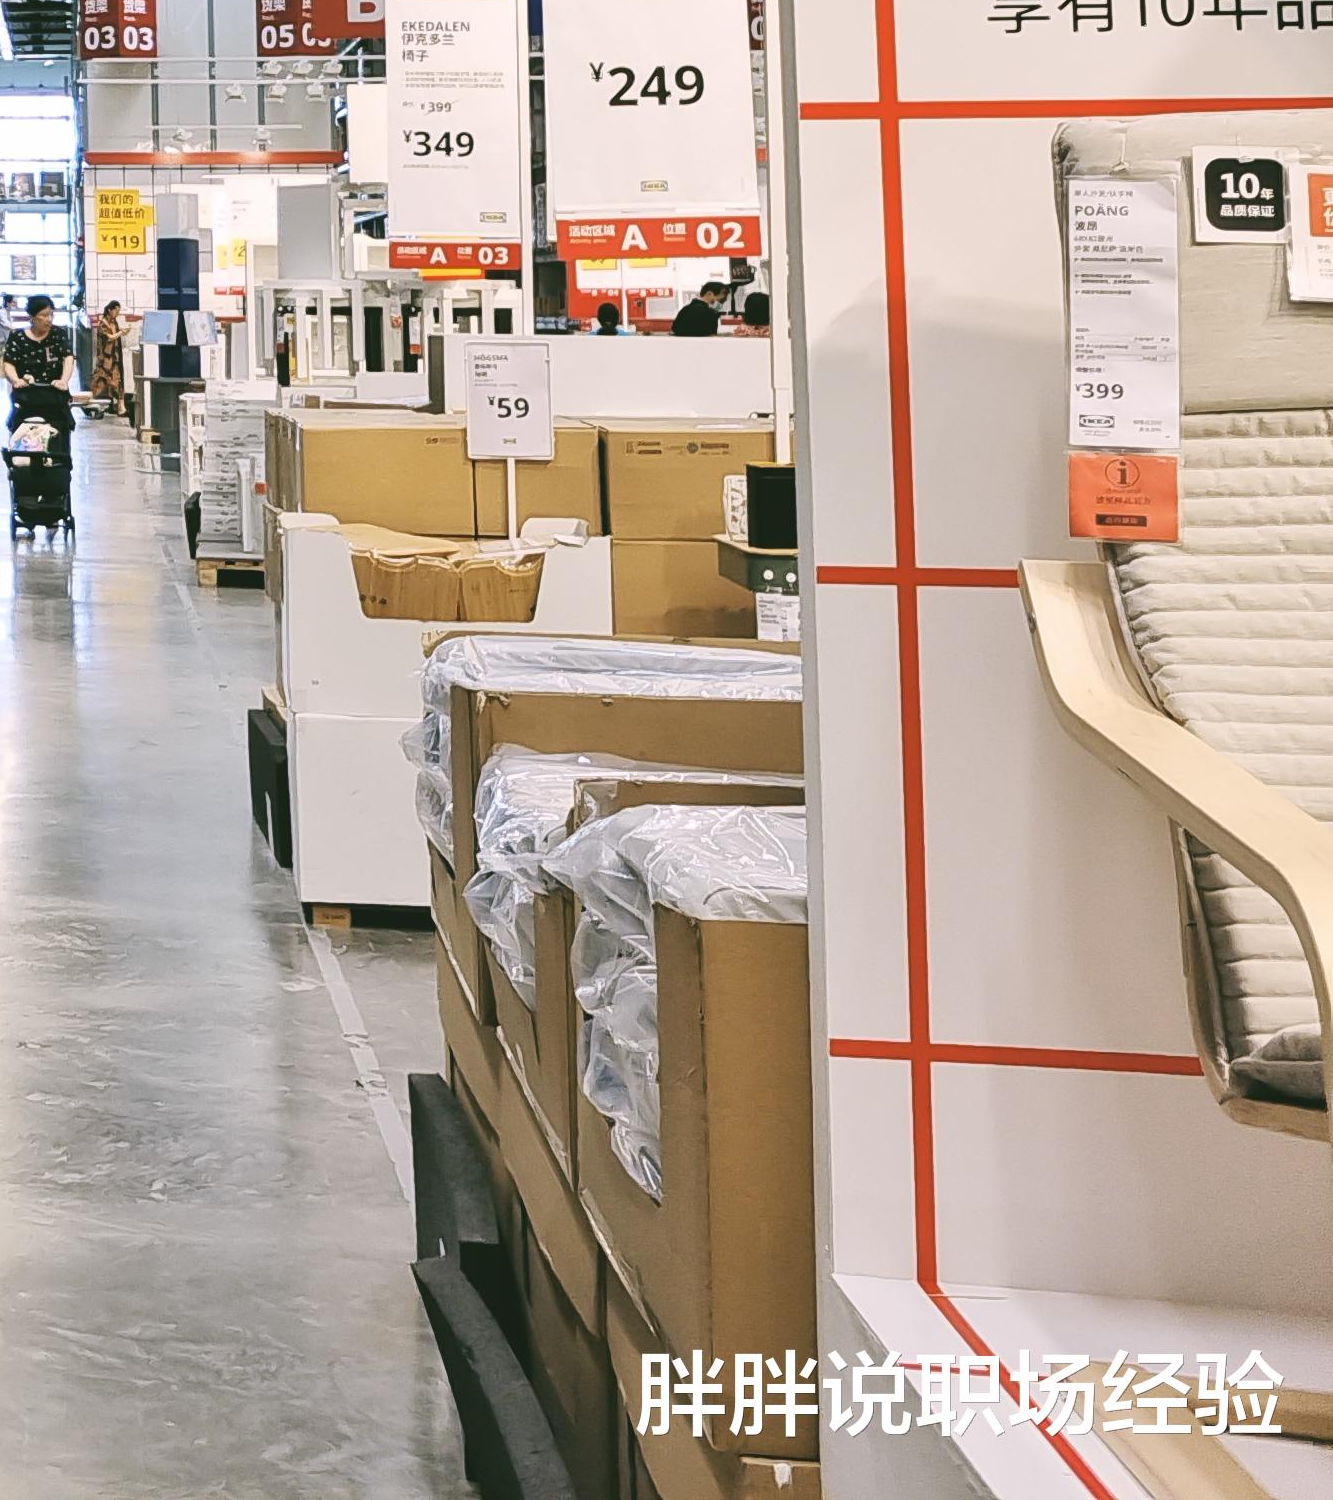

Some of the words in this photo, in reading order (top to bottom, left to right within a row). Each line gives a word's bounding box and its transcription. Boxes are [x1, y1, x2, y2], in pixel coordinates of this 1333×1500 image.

[402, 21, 471, 32] EKEDALEN
[84, 25, 116, 51] 03
[123, 26, 154, 51] 03
[261, 24, 294, 49] 05
[402, 33, 455, 46] 伊克多兰
[402, 49, 429, 62] 椅子
[99, 193, 134, 206] 我们的
[99, 208, 145, 219] 超值低价
[1074, 203, 1129, 216] POÄNG
[621, 224, 648, 251] A
[696, 222, 745, 250] 02
[430, 247, 448, 264] A
[478, 246, 509, 265] 03
